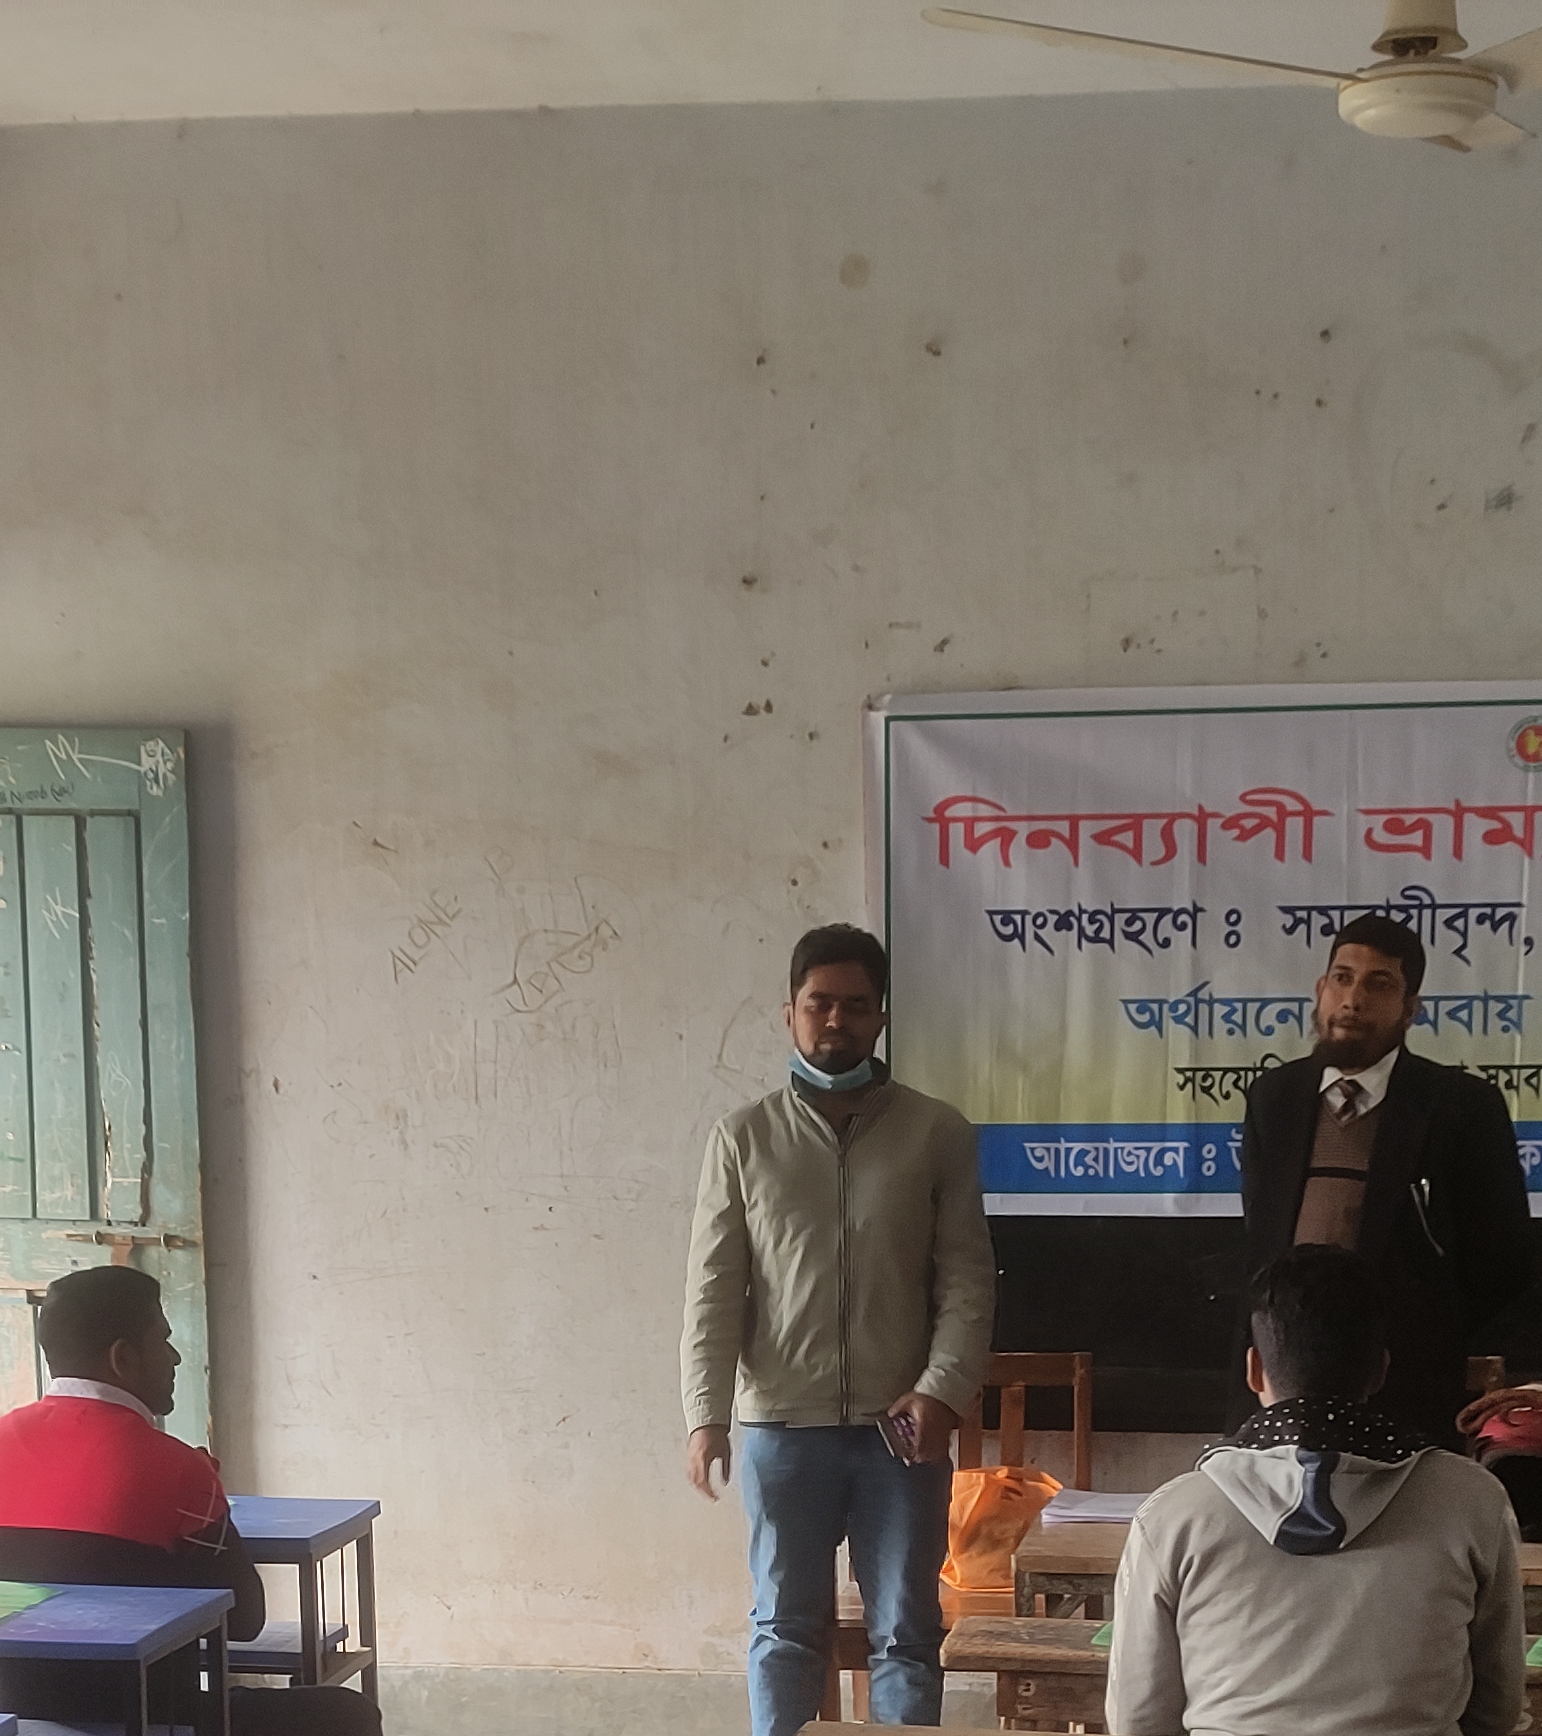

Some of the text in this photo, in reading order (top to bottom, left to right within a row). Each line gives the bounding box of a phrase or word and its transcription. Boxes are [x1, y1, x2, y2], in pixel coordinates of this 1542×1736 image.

[922, 786, 1331, 868] দিনব্যাপী
[389, 891, 463, 985] ALONE
[984, 900, 1206, 957] অংশগ্রহণে
[1118, 981, 1313, 1039] অর্থায়নে
[1023, 1137, 1191, 1179] আয়োজনে
